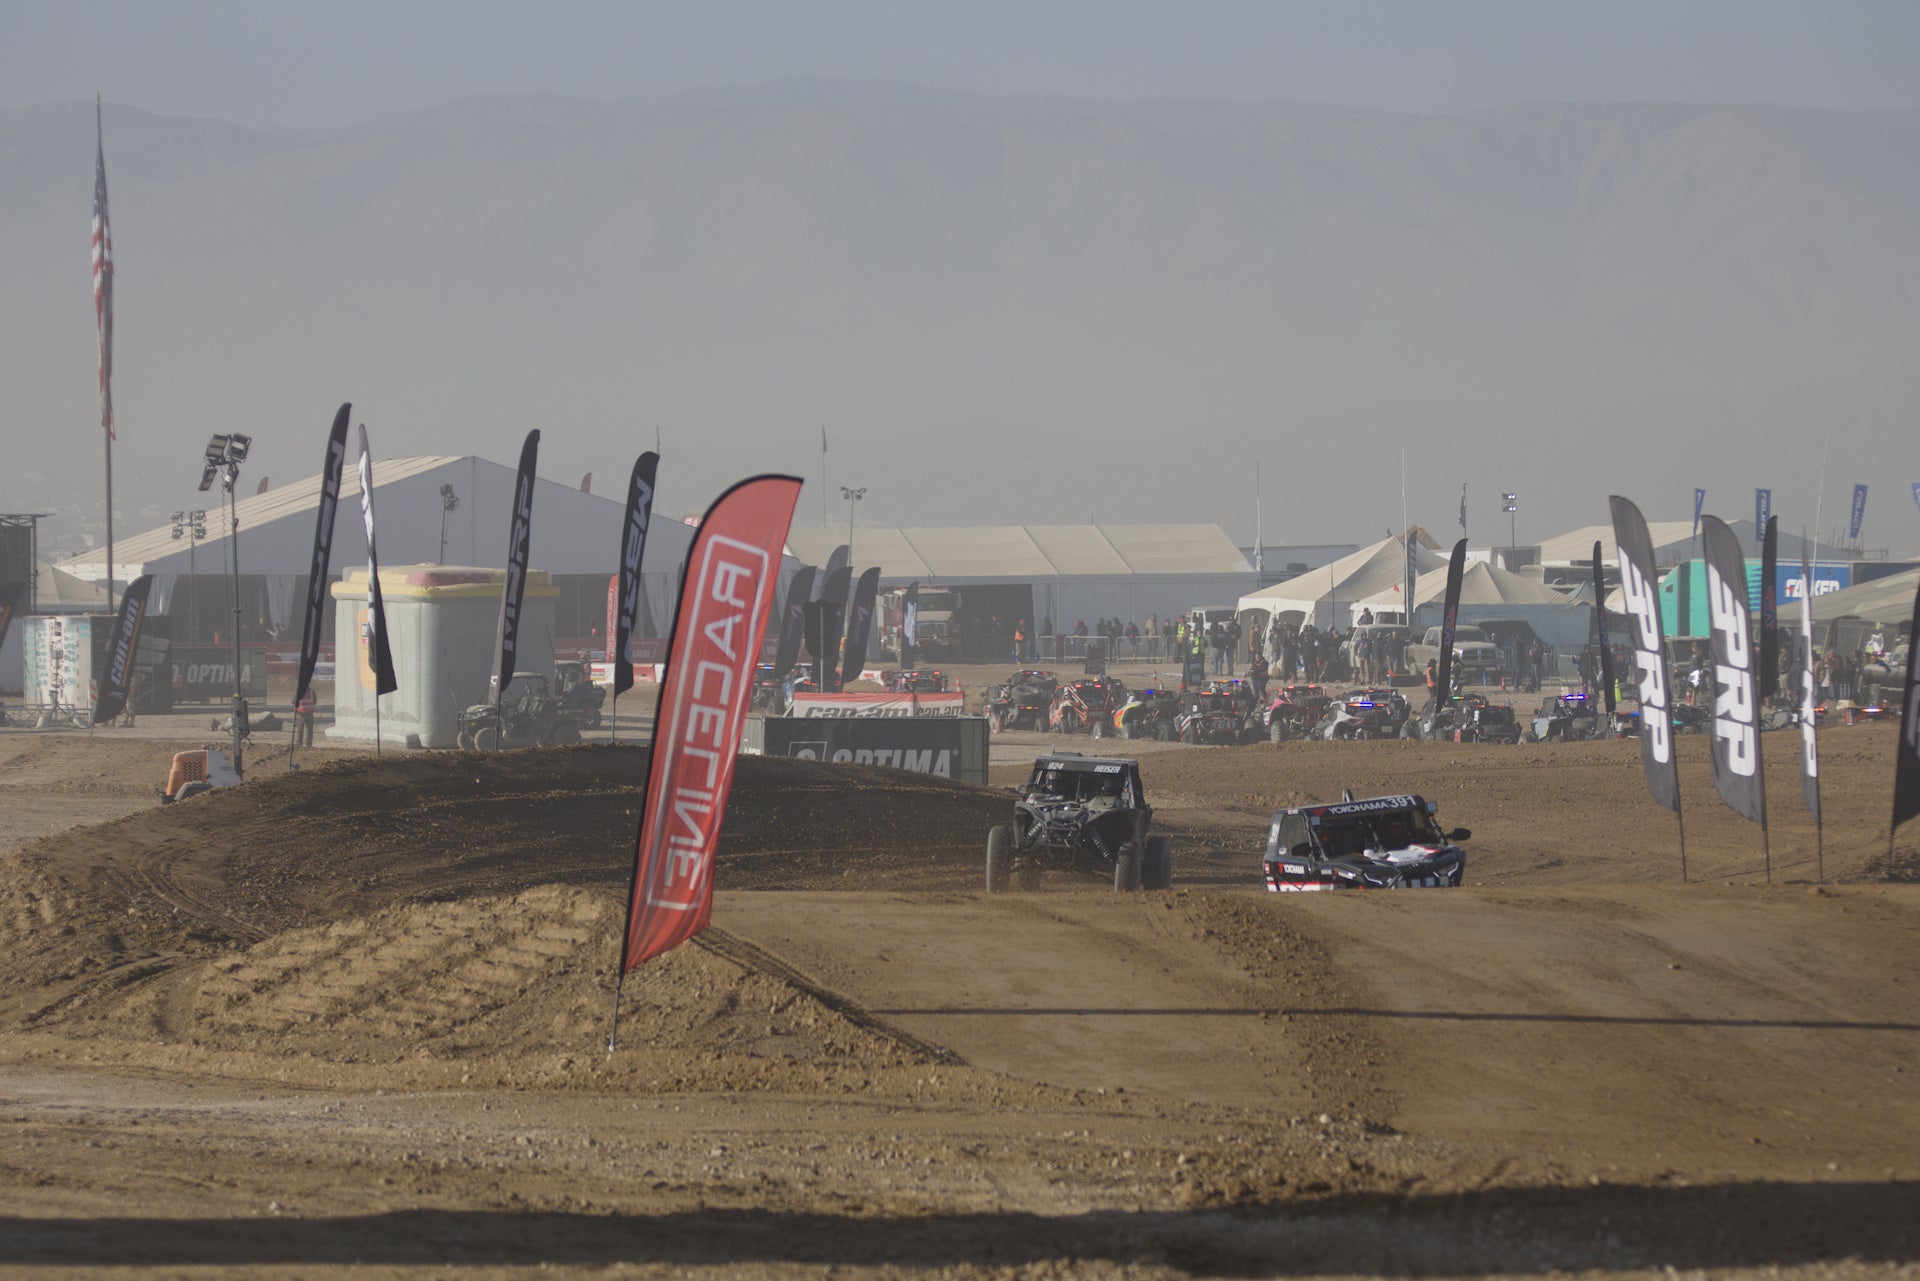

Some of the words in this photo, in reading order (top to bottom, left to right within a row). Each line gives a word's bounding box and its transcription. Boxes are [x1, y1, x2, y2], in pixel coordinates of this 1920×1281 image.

[504, 474, 530, 652] MBRP
[1786, 579, 1840, 598] FAKEN
[110, 597, 139, 686] can-am
[1618, 546, 1669, 763] PRP
[1709, 563, 1755, 777] PRP
[1047, 762, 1064, 770] 924
[1328, 802, 1388, 815] YOKOHAMA
[1387, 796, 1417, 809] 391
